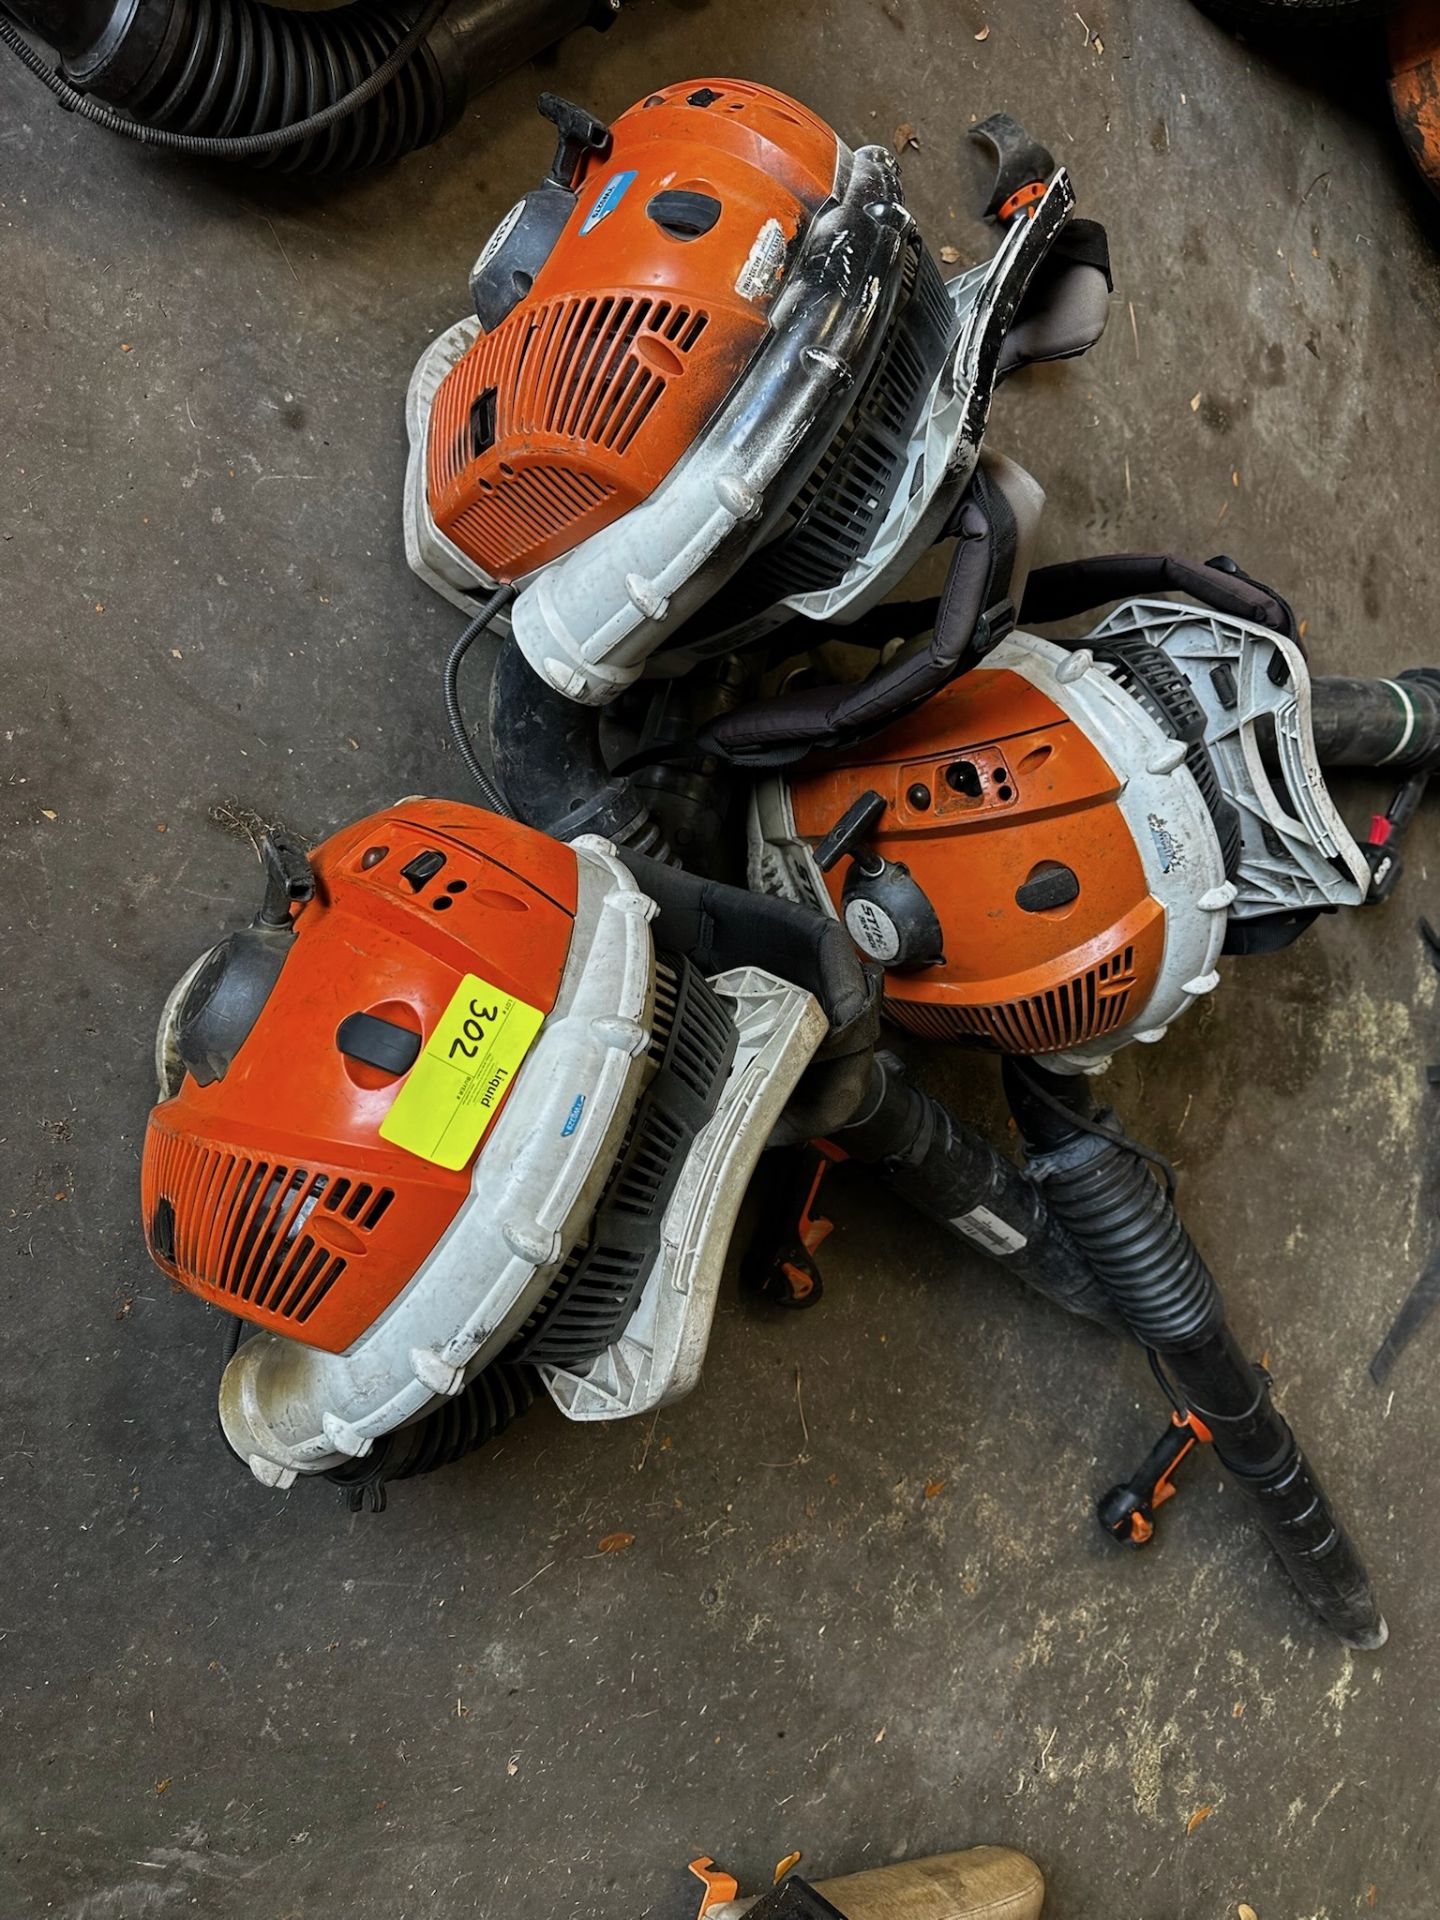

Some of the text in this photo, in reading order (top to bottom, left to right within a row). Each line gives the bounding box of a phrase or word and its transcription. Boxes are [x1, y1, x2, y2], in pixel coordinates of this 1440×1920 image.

[449, 999, 498, 1059] 302
[457, 1077, 472, 1096] BUYER
[480, 1067, 508, 1108] Liquid
